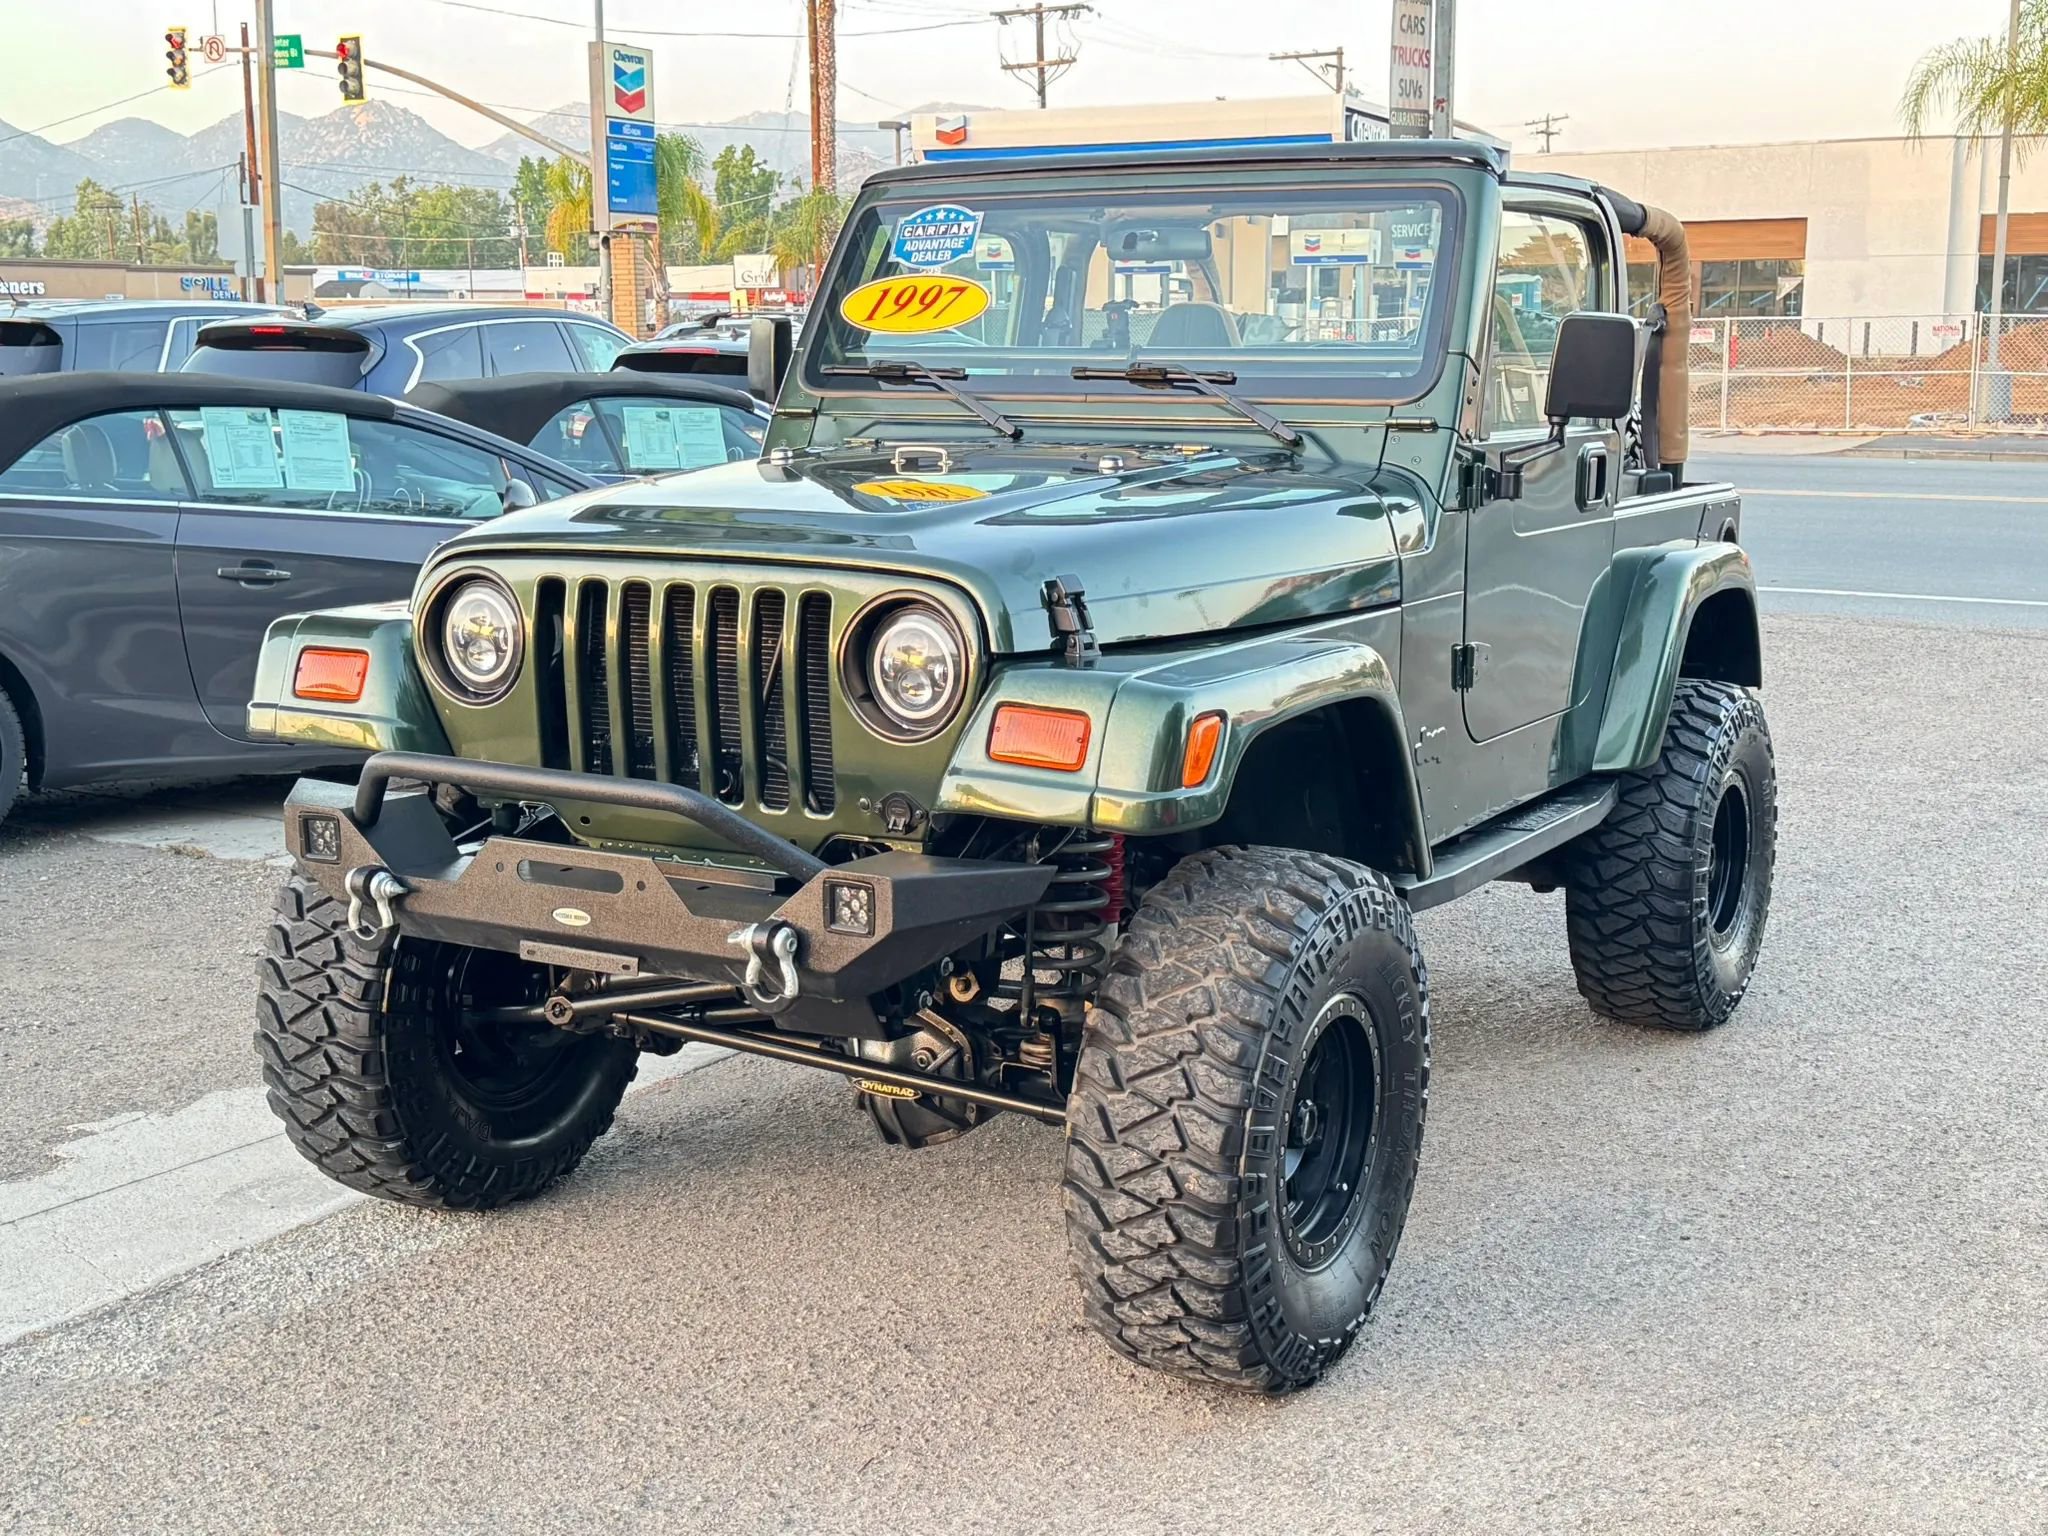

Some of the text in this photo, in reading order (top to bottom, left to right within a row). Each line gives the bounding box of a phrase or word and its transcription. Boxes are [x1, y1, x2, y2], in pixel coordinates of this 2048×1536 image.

[1399, 13, 1425, 36] CARS
[273, 38, 289, 47] inter
[613, 49, 645, 66] Chevron
[1392, 45, 1431, 69] TRUCKS
[1398, 78, 1424, 99] SUVs
[903, 222, 972, 237] CARFAX
[1391, 223, 1430, 238] SERVICE
[903, 238, 966, 252] ADVANTAGE
[910, 251, 952, 262] DEALER
[741, 270, 772, 284] Gril
[212, 290, 241, 300] DENTA
[861, 284, 969, 322] 1997
[861, 1080, 915, 1097] DYNATRAC
